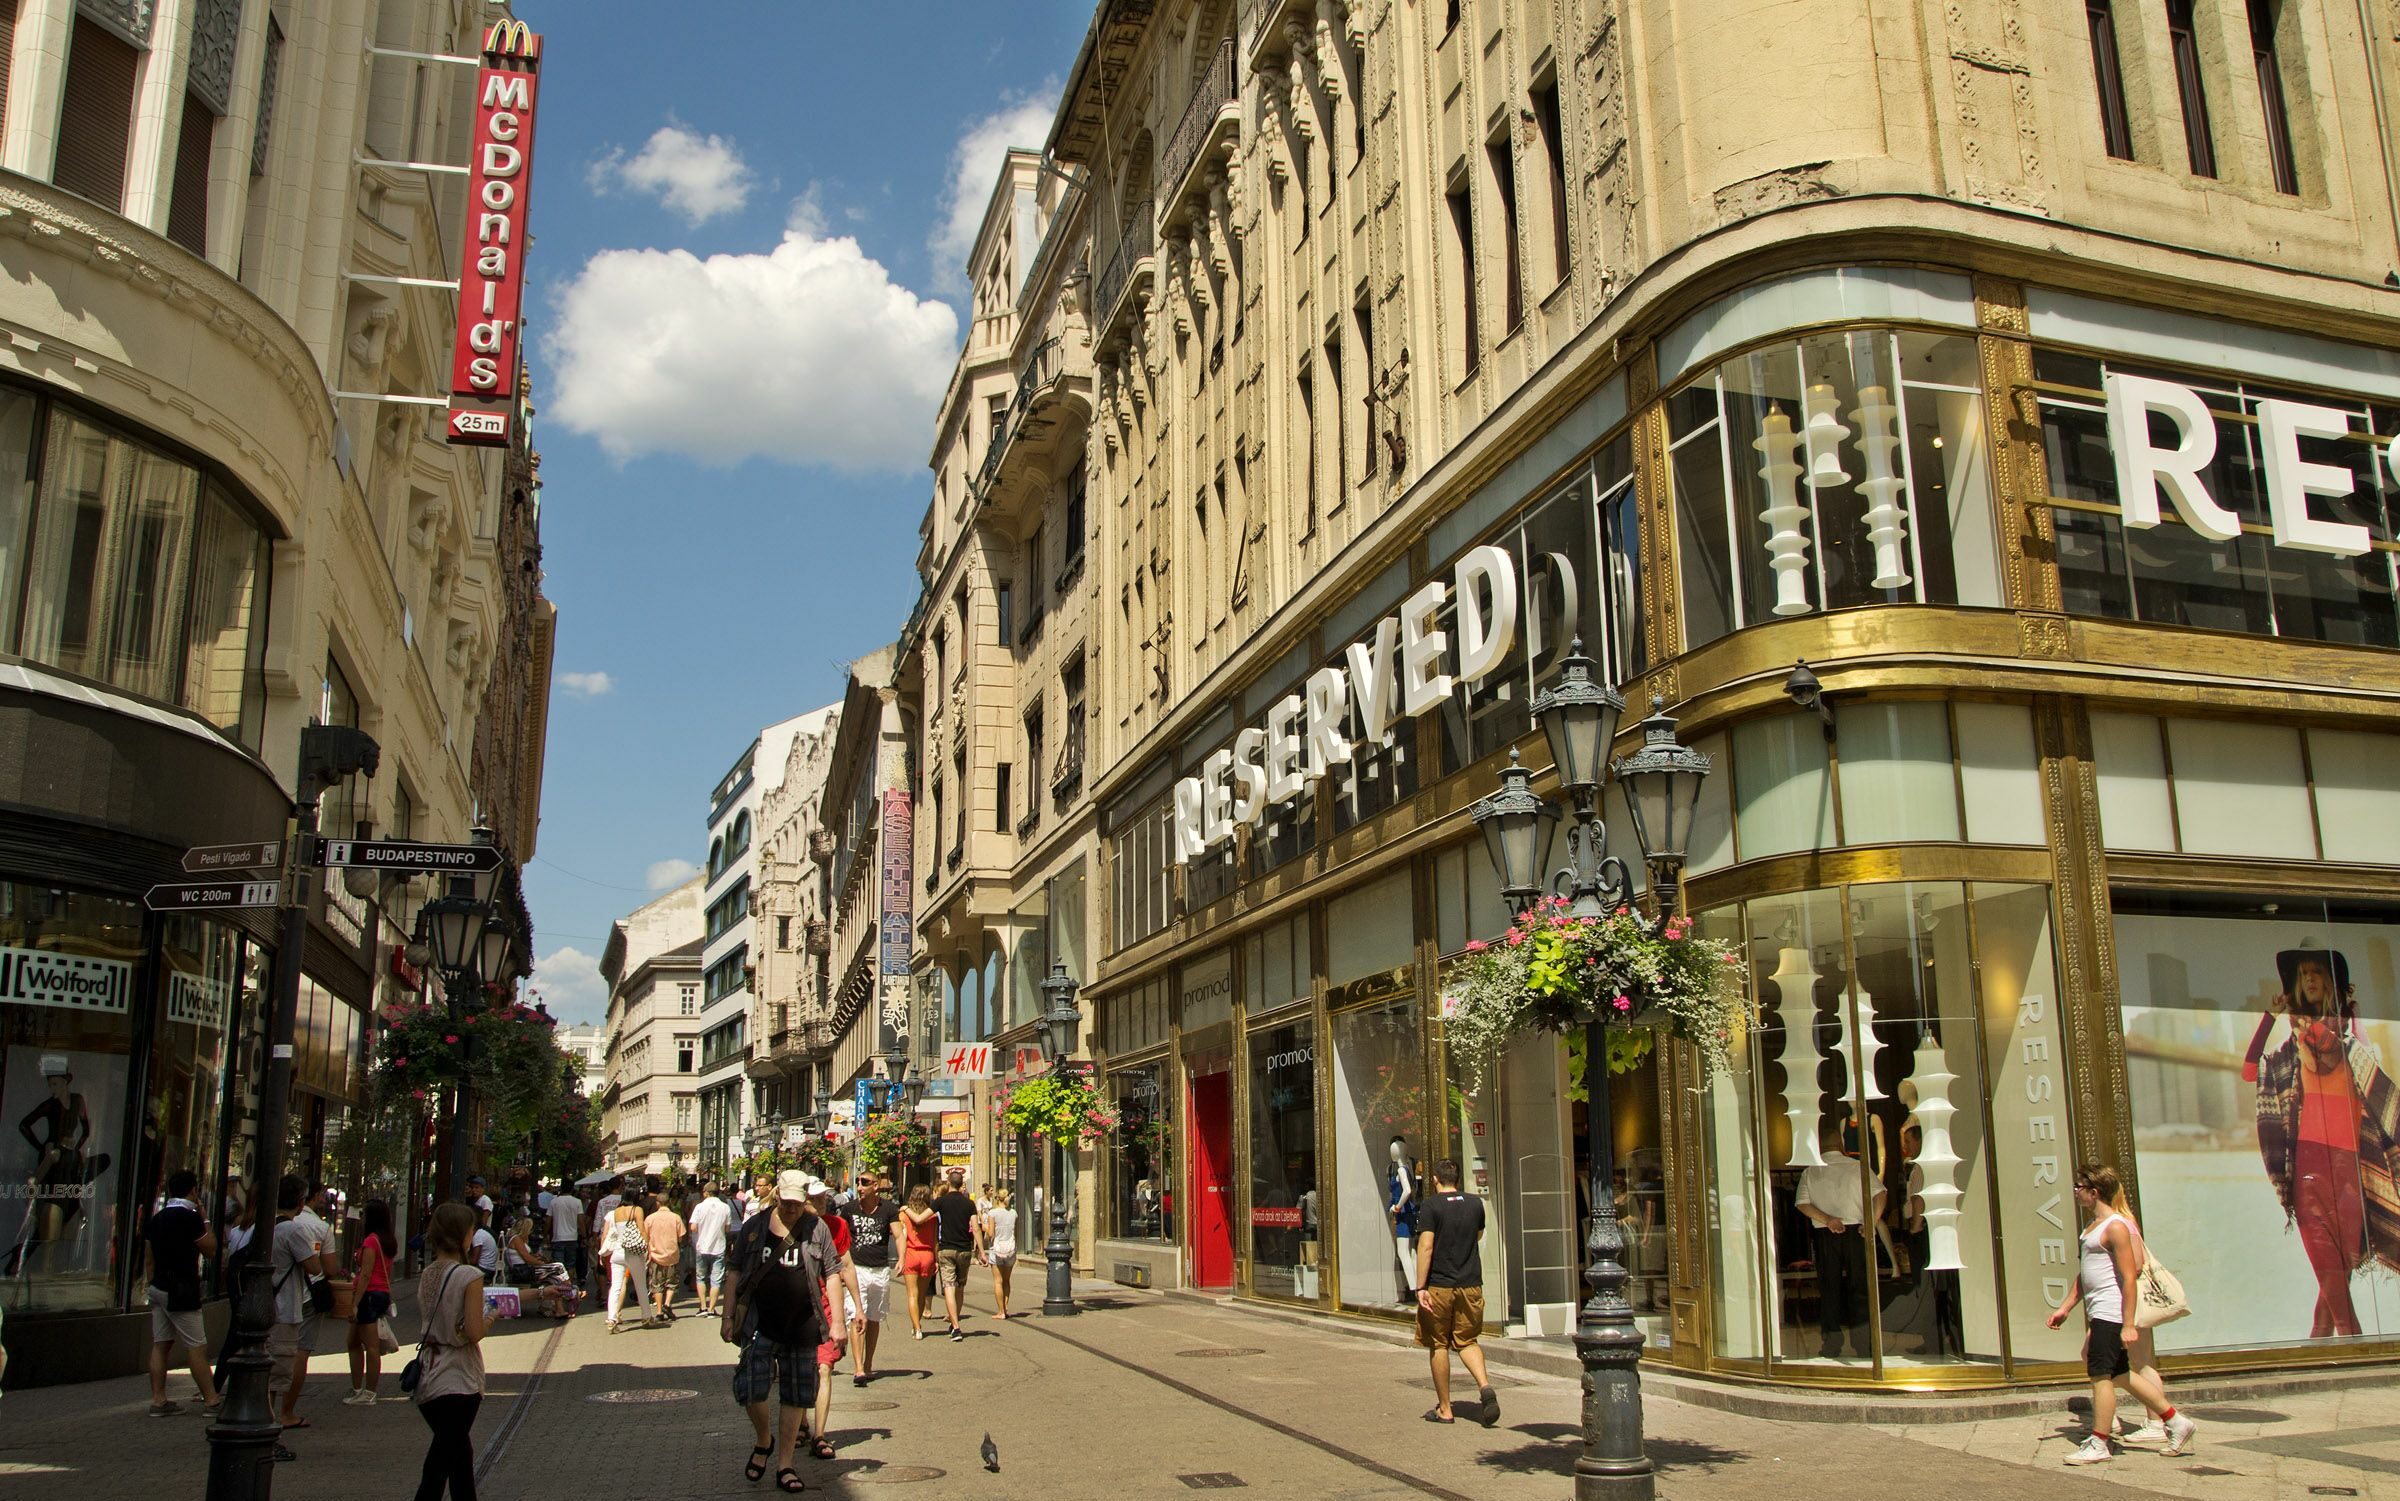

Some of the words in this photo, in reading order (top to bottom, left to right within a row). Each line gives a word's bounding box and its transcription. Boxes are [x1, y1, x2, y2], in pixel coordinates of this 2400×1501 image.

[469, 75, 529, 389] McDonald's
[462, 415, 483, 431] 25
[484, 419, 501, 432] m
[2105, 373, 2400, 557] RE
[1174, 545, 1517, 864] RESERVED
[200, 853, 221, 865] Pesti
[223, 851, 251, 865] Vigadó
[366, 848, 475, 865] BUDAPESTINFO
[181, 890, 199, 902] WC
[202, 889, 231, 902] 200m
[27, 966, 109, 996] Wolford
[1184, 972, 1230, 1012] promod
[946, 1047, 987, 1075] H&M
[1132, 1082, 1160, 1101] promo
[944, 1143, 968, 1151] CHANGE
[2019, 994, 2069, 1309] RESERVED
